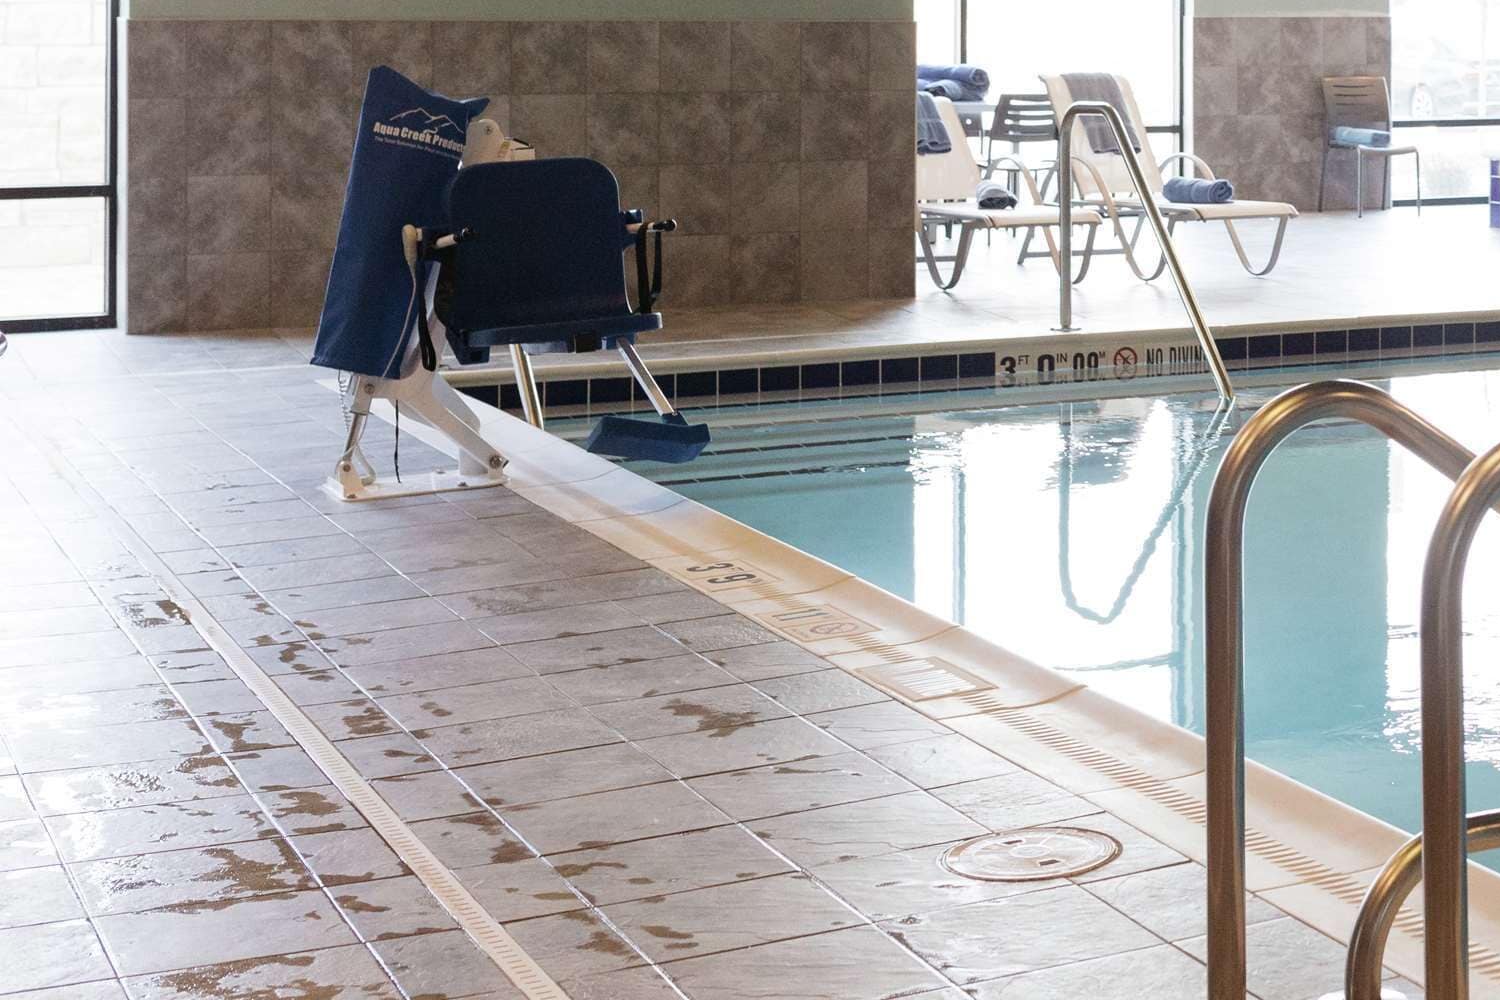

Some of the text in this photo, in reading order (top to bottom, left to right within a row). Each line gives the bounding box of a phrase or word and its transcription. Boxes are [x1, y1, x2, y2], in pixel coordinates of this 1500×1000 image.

[373, 122, 400, 136] Aqua
[400, 127, 433, 143] Creek
[1169, 345, 1206, 363] DIVIN
